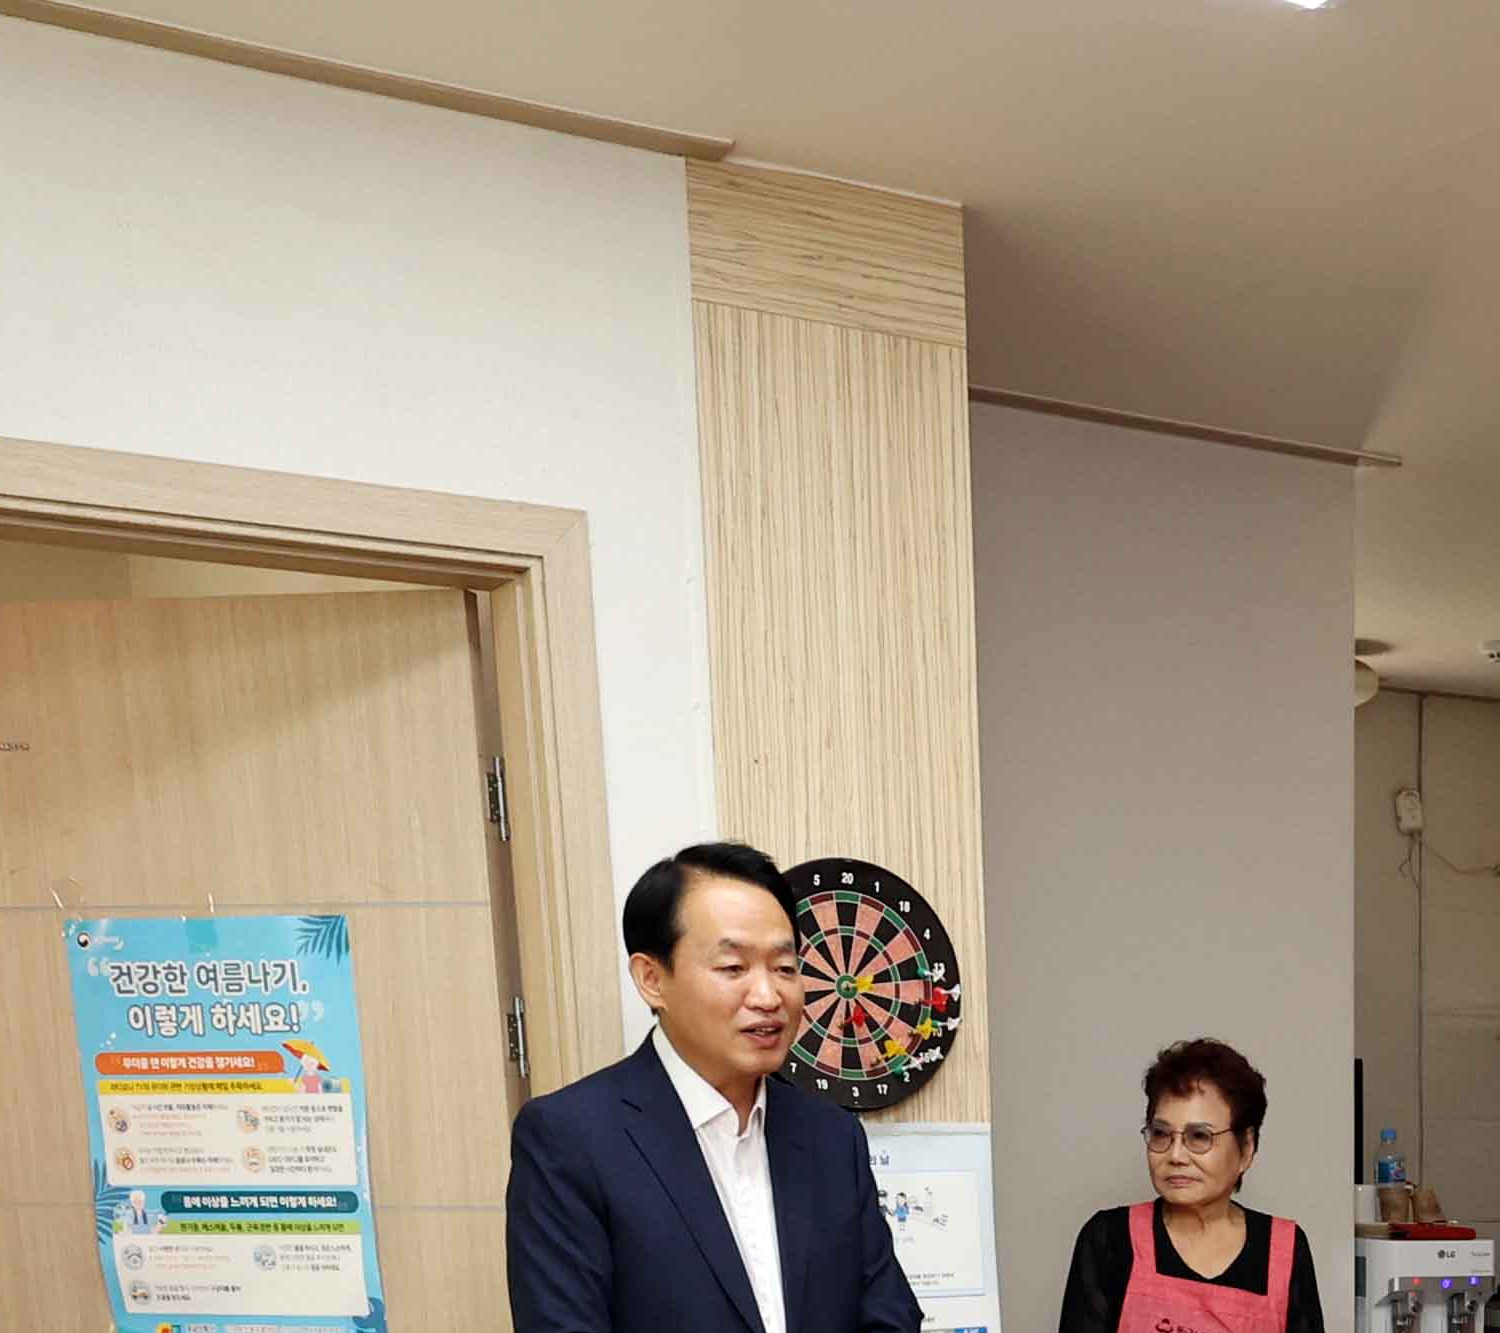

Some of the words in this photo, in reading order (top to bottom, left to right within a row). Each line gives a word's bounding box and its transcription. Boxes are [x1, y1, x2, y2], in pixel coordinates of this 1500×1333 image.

[813, 874, 821, 886] 5
[841, 872, 854, 884] 20
[874, 881, 880, 893] 1
[899, 901, 910, 912] 18
[923, 928, 932, 940] 4
[108, 961, 188, 996] 건강한
[195, 961, 310, 994] 여름나기,
[127, 1002, 206, 1036] 이렇게
[210, 1001, 302, 1035] 하세요!
[790, 1062, 798, 1073] 7
[903, 1071, 911, 1083] 2
[816, 1078, 829, 1090] 19
[877, 1083, 889, 1095] 17
[852, 1086, 860, 1097] 3
[1446, 1250, 1457, 1259] LG
